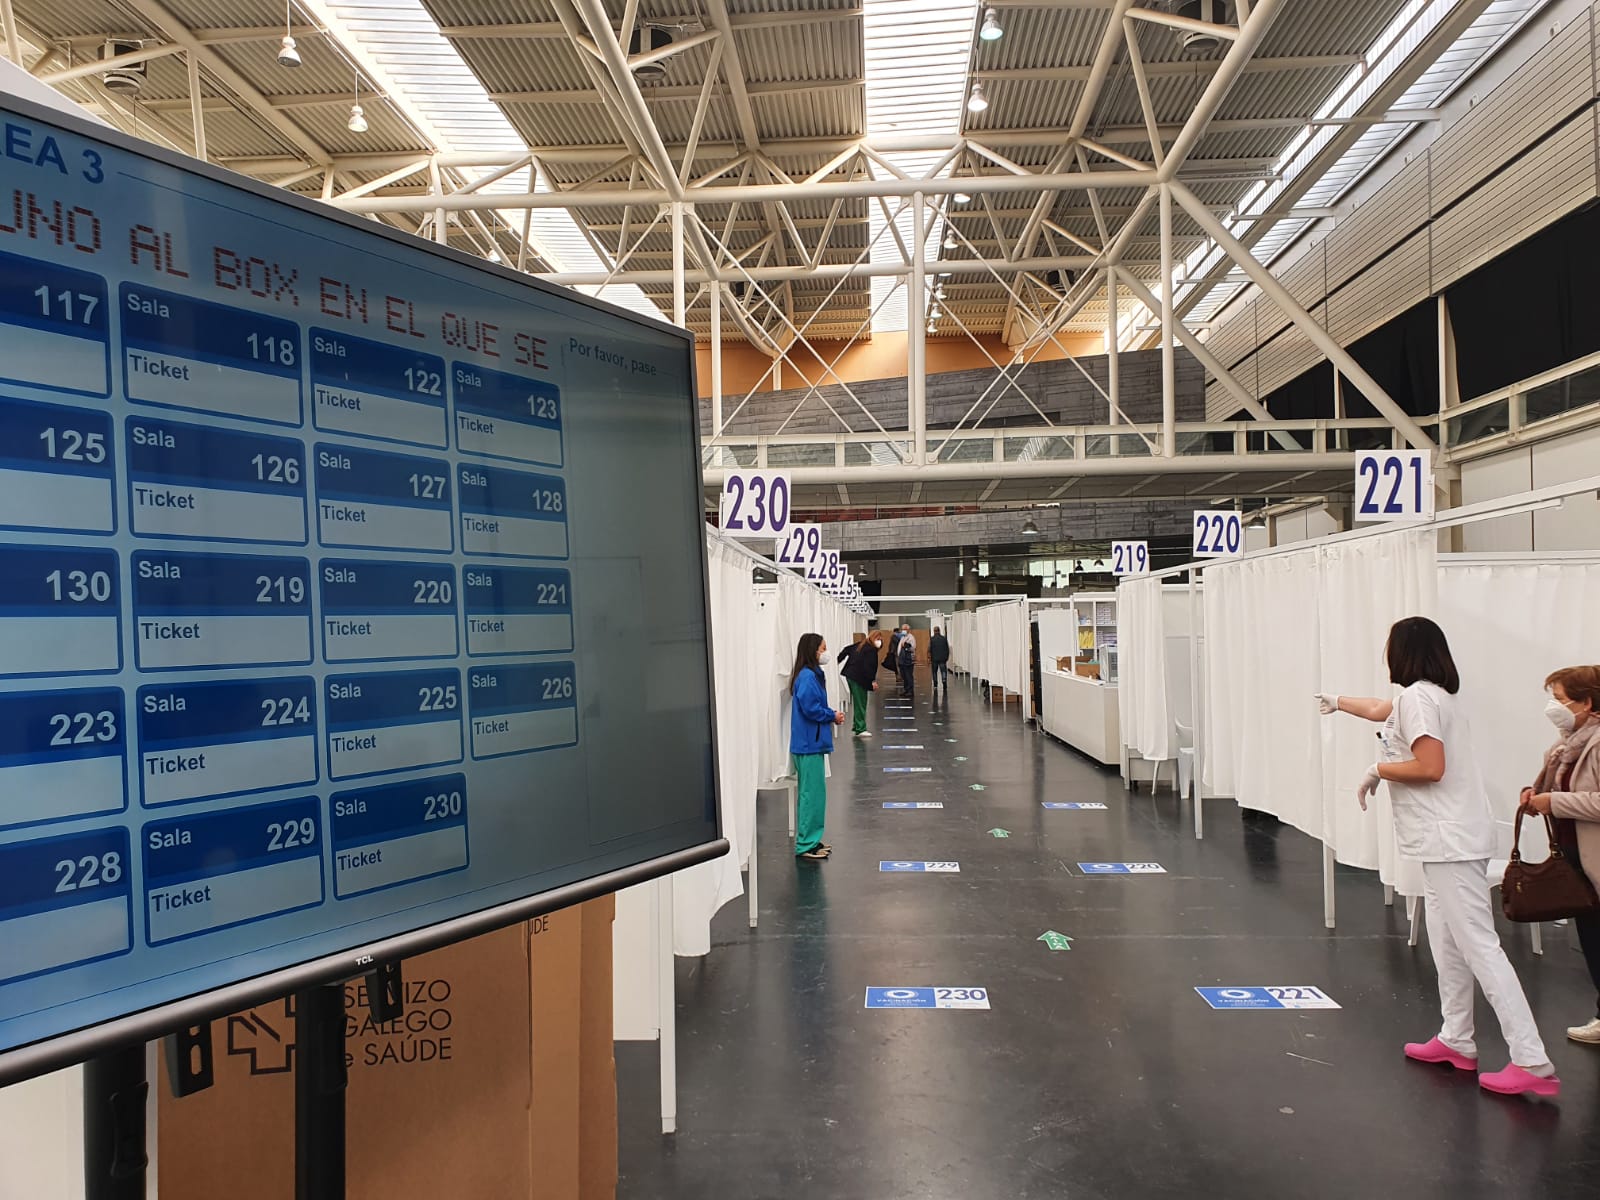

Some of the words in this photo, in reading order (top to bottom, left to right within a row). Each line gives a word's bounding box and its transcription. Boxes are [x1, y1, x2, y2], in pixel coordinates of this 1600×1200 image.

[0, 122, 68, 175] EA
[82, 149, 104, 184] 3
[34, 284, 99, 325] 117
[130, 223, 189, 279] AL
[213, 246, 299, 307] BOX
[320, 276, 369, 325] EN
[385, 295, 426, 338] EL
[441, 312, 500, 358] QUE
[513, 332, 549, 370] SE
[127, 293, 170, 319] Sala
[247, 332, 295, 367] 118
[129, 353, 190, 382] Ticket
[313, 336, 347, 358] Sala
[403, 366, 442, 397] 122
[569, 337, 591, 357] Por
[595, 346, 628, 369] favor,
[631, 360, 657, 376] pase
[316, 389, 361, 412] Ticket
[456, 369, 482, 388] Sala
[527, 394, 558, 420] 123
[458, 416, 494, 435] Ticket
[39, 426, 106, 464] 125
[132, 426, 175, 449] Sala
[251, 453, 300, 484] 126
[319, 452, 351, 471] Sala
[408, 473, 446, 500] 127
[462, 471, 487, 488] Sala
[532, 488, 563, 513] 128
[1359, 456, 1422, 514] 221
[135, 487, 195, 510] Ticket
[321, 504, 366, 523] Ticket
[725, 475, 788, 532] 230
[464, 517, 500, 534] Ticket
[1196, 515, 1240, 553] 220
[1114, 544, 1146, 572] 219
[46, 569, 111, 602] 130
[138, 560, 181, 580] Sala
[255, 575, 305, 603] 219
[324, 567, 356, 583] Sala
[413, 580, 452, 604] 220
[467, 573, 492, 587] Sala
[537, 583, 566, 605] 221
[141, 621, 200, 640] Ticket
[327, 620, 372, 636] Ticket
[469, 619, 505, 633] Ticket
[330, 683, 362, 699] Sala
[418, 685, 457, 712] 225
[472, 673, 497, 688] Sala
[542, 676, 573, 700] 226
[144, 694, 187, 713] Sala
[261, 696, 310, 727] 224
[49, 710, 117, 746] 223
[332, 734, 377, 753] Ticket
[474, 719, 510, 736] Ticket
[146, 752, 206, 776] Ticket
[335, 799, 367, 817] Sala
[423, 791, 462, 821] 230
[149, 829, 192, 850] Sala
[266, 817, 315, 852] 229
[54, 851, 122, 894] 228
[337, 848, 382, 871] Ticket
[151, 885, 211, 913] Ticket
[356, 955, 373, 966] TCL
[345, 979, 451, 1009] SEIZO
[937, 989, 986, 1001] 230
[1267, 987, 1324, 1000] 221
[364, 1034, 452, 1066] SAÚDE
